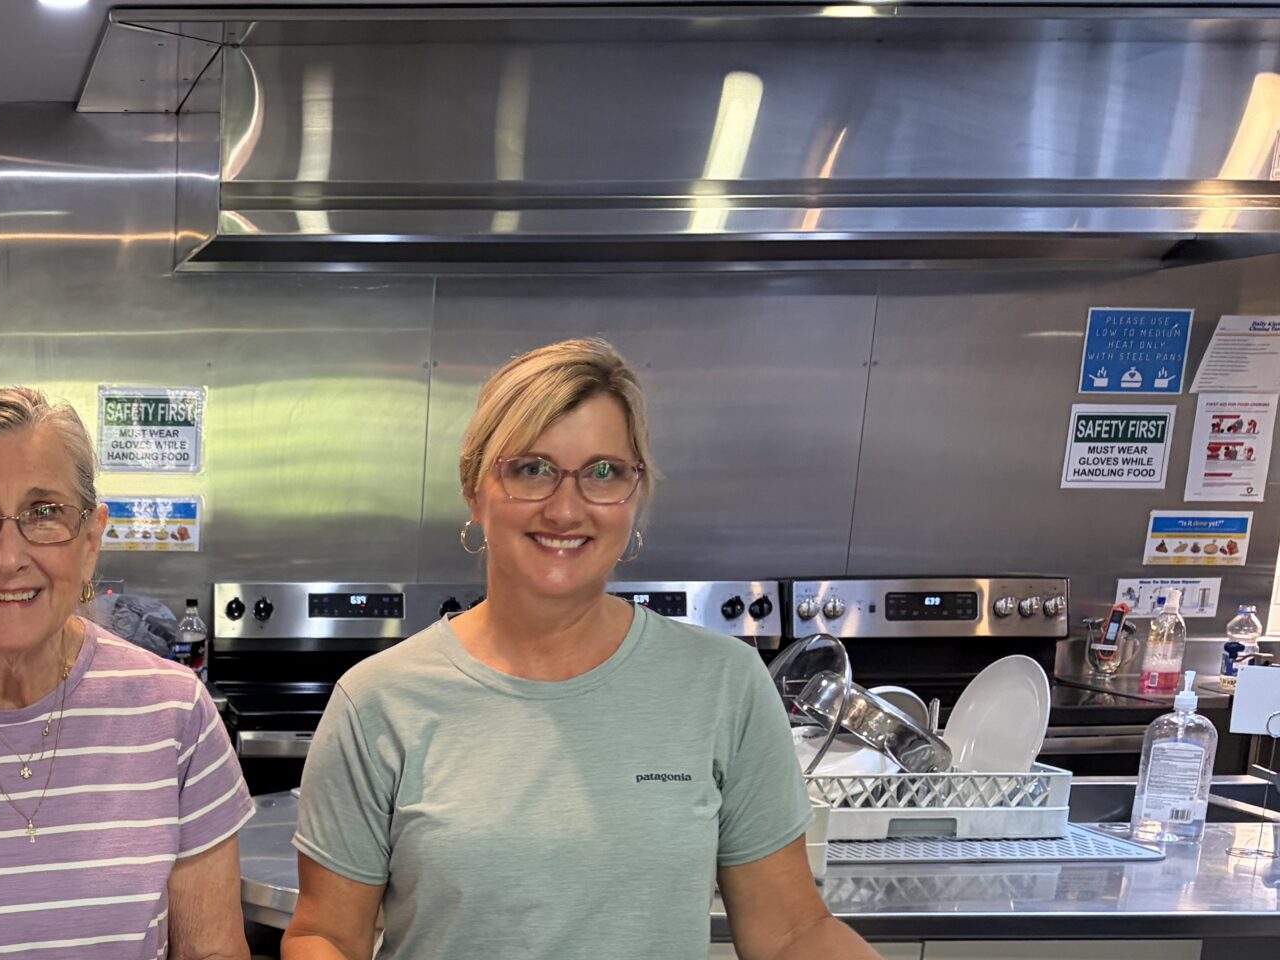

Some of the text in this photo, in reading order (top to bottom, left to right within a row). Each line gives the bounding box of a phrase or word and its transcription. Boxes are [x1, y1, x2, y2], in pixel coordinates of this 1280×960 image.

[1105, 316, 1170, 326] PLEASE USE
[1095, 328, 1181, 337] LOW TO MEDIUM
[1108, 340, 1166, 349] HEAT ONLY
[1087, 352, 1182, 361] WITH STEEL PANS
[106, 402, 194, 422] SAFETY FIRST
[119, 429, 180, 438] MUST WEAR
[1076, 419, 1165, 439] SAFETY FIRST
[111, 440, 187, 450] GLOVES WHILE
[1087, 445, 1148, 455] MUST WEAR
[107, 451, 190, 461] HANDLING FOOD
[1078, 457, 1154, 466] GLOVES WHILE
[1072, 468, 1156, 477] HANDLING FOOD
[635, 772, 693, 783] patagonia
